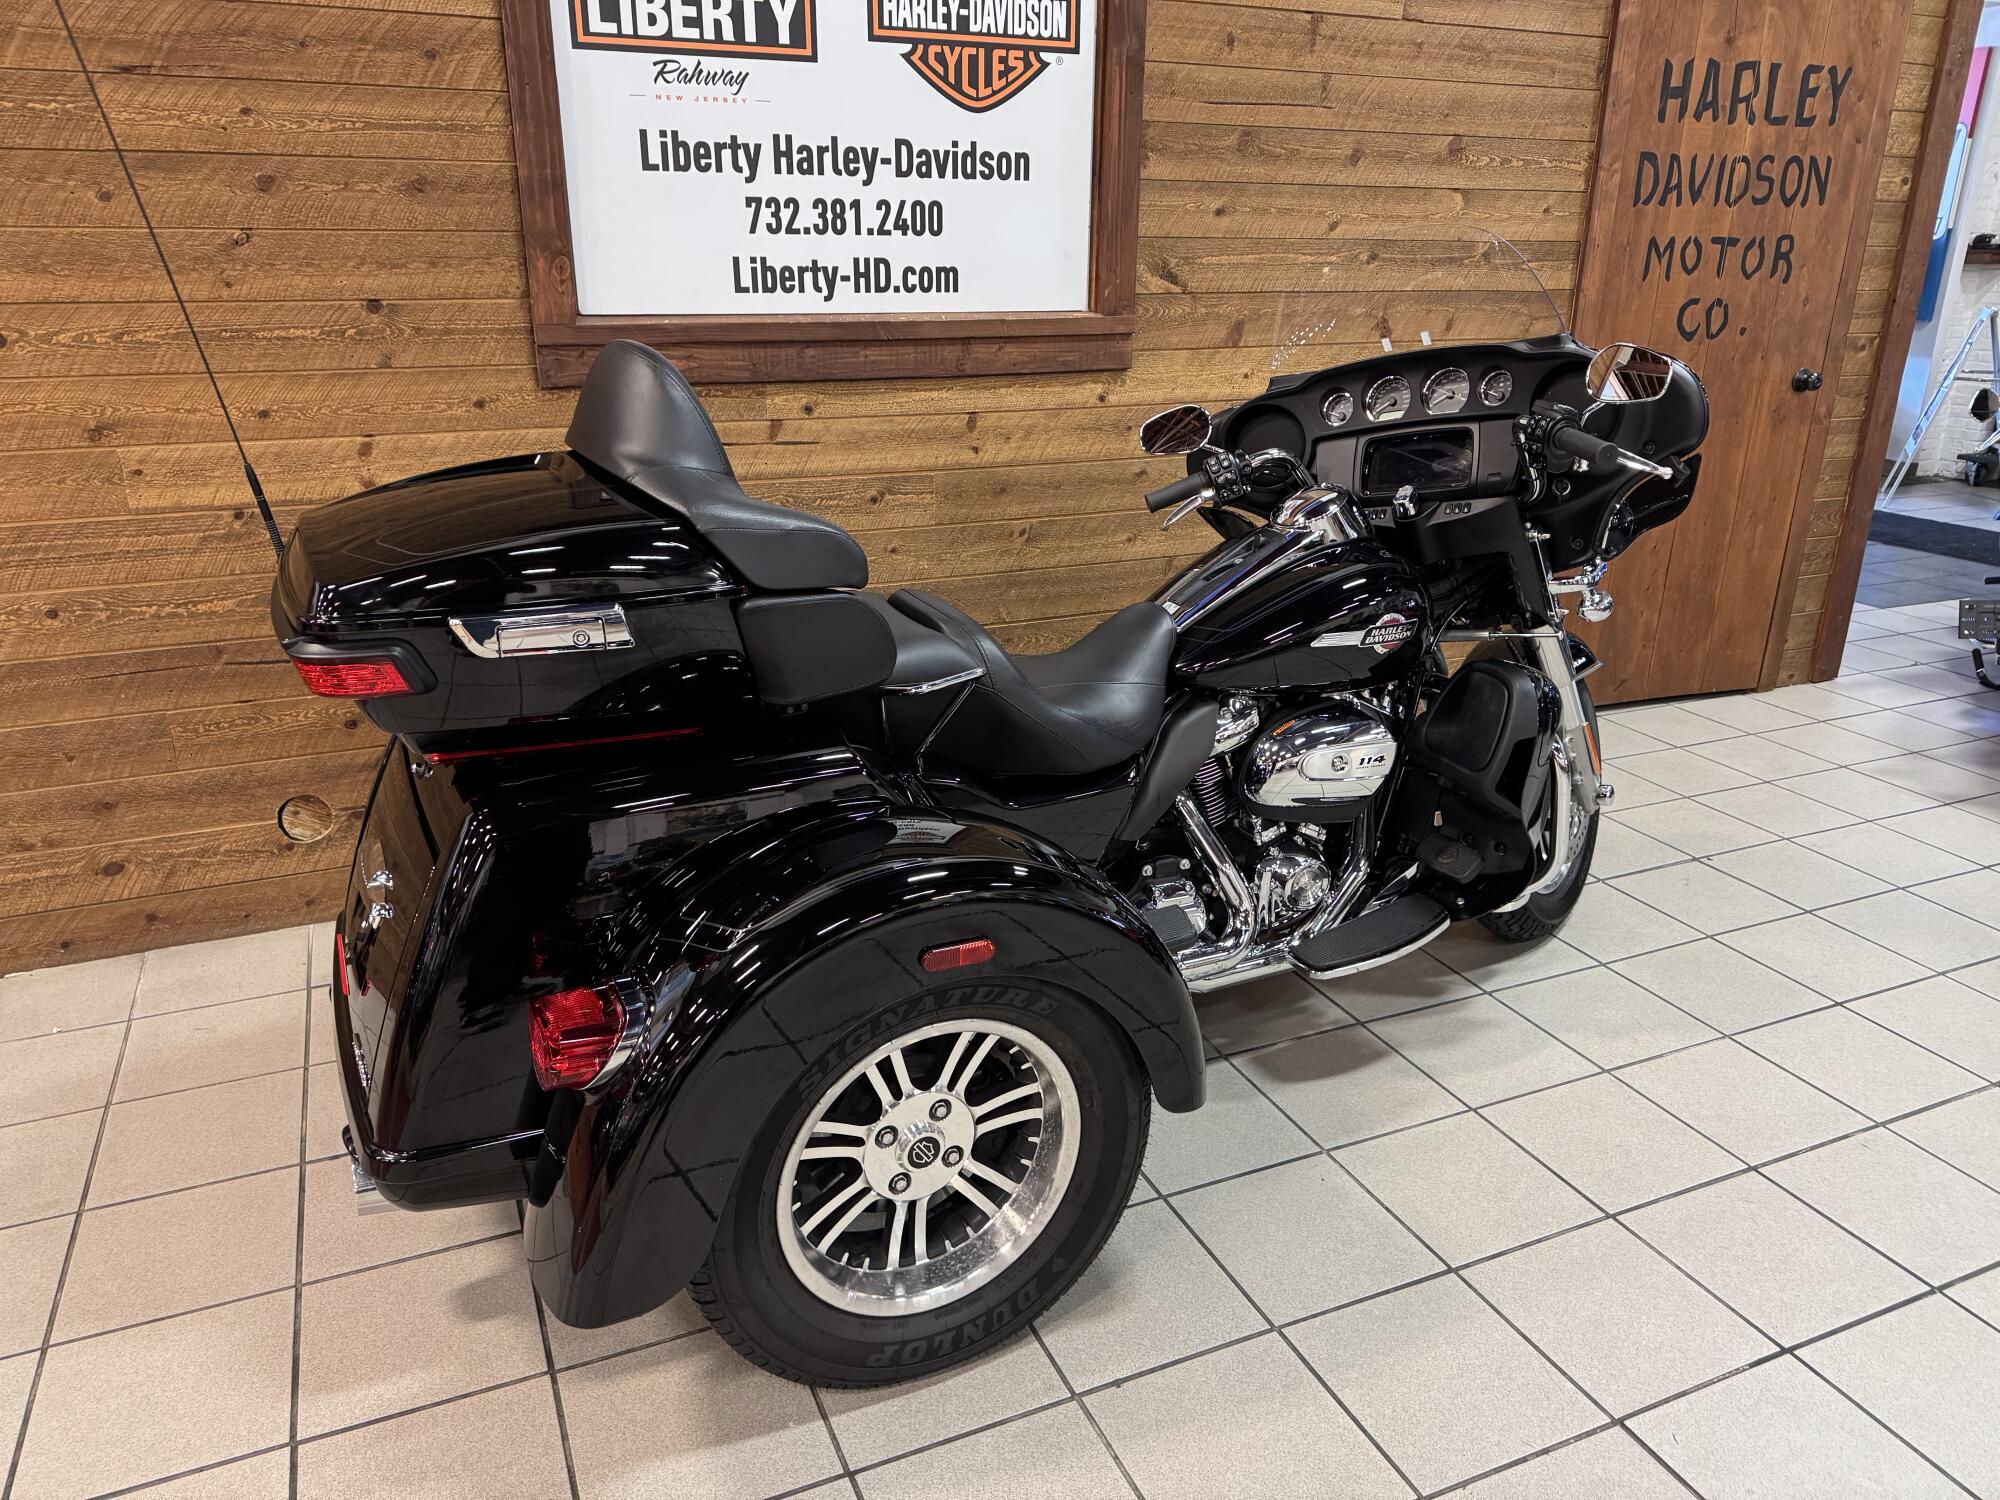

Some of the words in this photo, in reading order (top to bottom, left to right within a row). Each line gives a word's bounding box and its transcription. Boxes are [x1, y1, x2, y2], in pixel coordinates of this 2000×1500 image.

[588, 0, 799, 45] LIBERTY
[883, 0, 1067, 38] HARLEY-DAVIDSON
[653, 59, 749, 95] Rahway
[927, 44, 1024, 97] CYCLES
[1657, 56, 1853, 127] HARLEY
[639, 129, 761, 183] Liberty
[773, 134, 1030, 186] Harley-Davidson
[1632, 151, 1833, 208] DAVIDSON
[745, 196, 944, 237] 732.381.2400
[733, 256, 959, 302] Liberty-HD.com
[1642, 234, 1795, 284] MOTOR
[1676, 297, 1748, 342] CO.
[1364, 630, 1412, 643] DAVIDSON
[1371, 623, 1412, 636] HARLEY
[1359, 755, 1386, 766] 114
[866, 1276, 1043, 1368] DUNLOP
